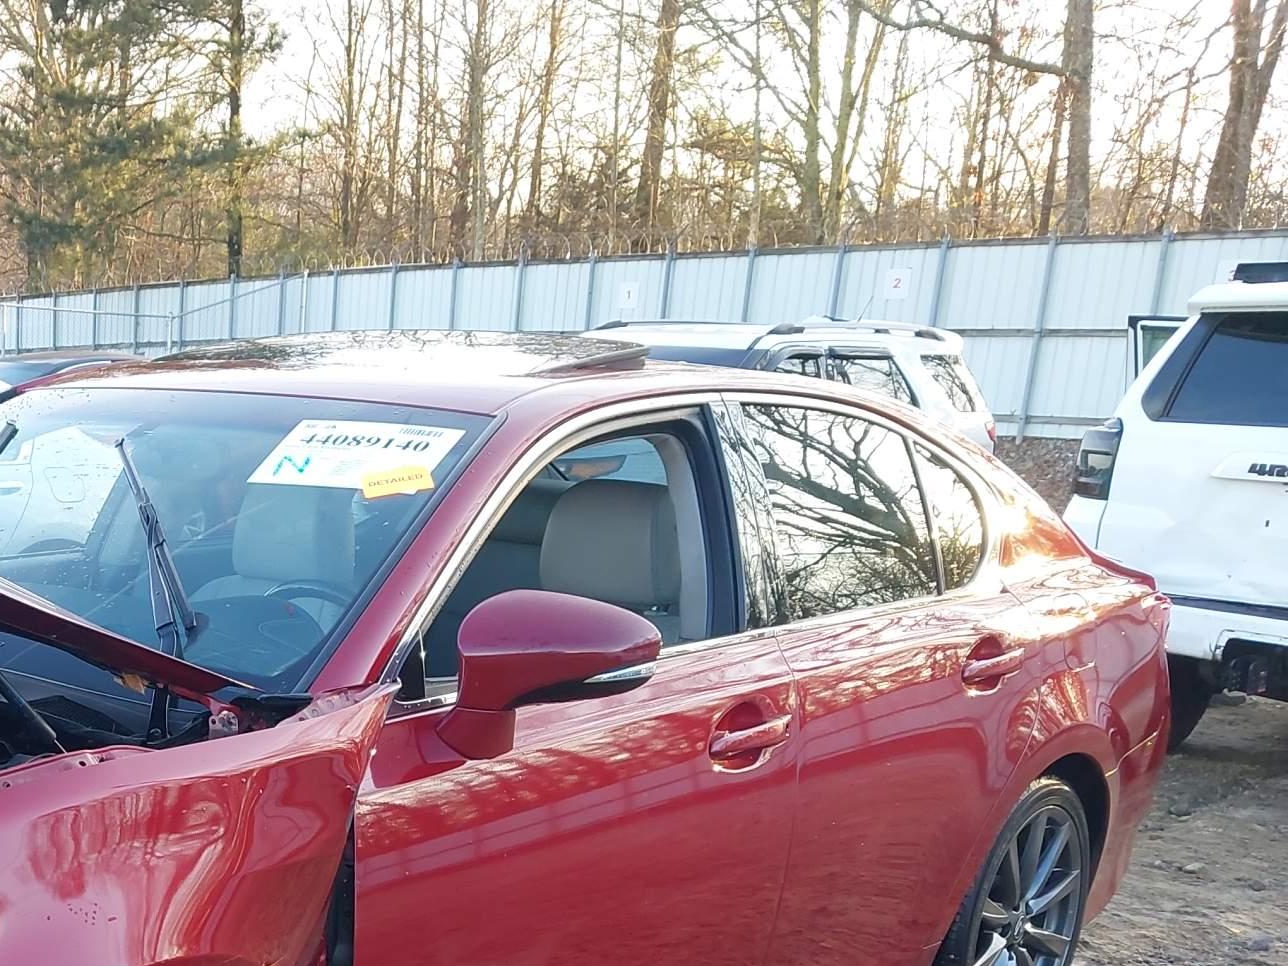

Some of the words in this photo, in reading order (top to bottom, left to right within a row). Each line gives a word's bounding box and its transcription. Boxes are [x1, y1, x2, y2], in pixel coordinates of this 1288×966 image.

[893, 278, 902, 289] 2
[300, 433, 430, 452] 44089140
[1247, 463, 1288, 478] 4R
[368, 473, 423, 487] DETAILED
